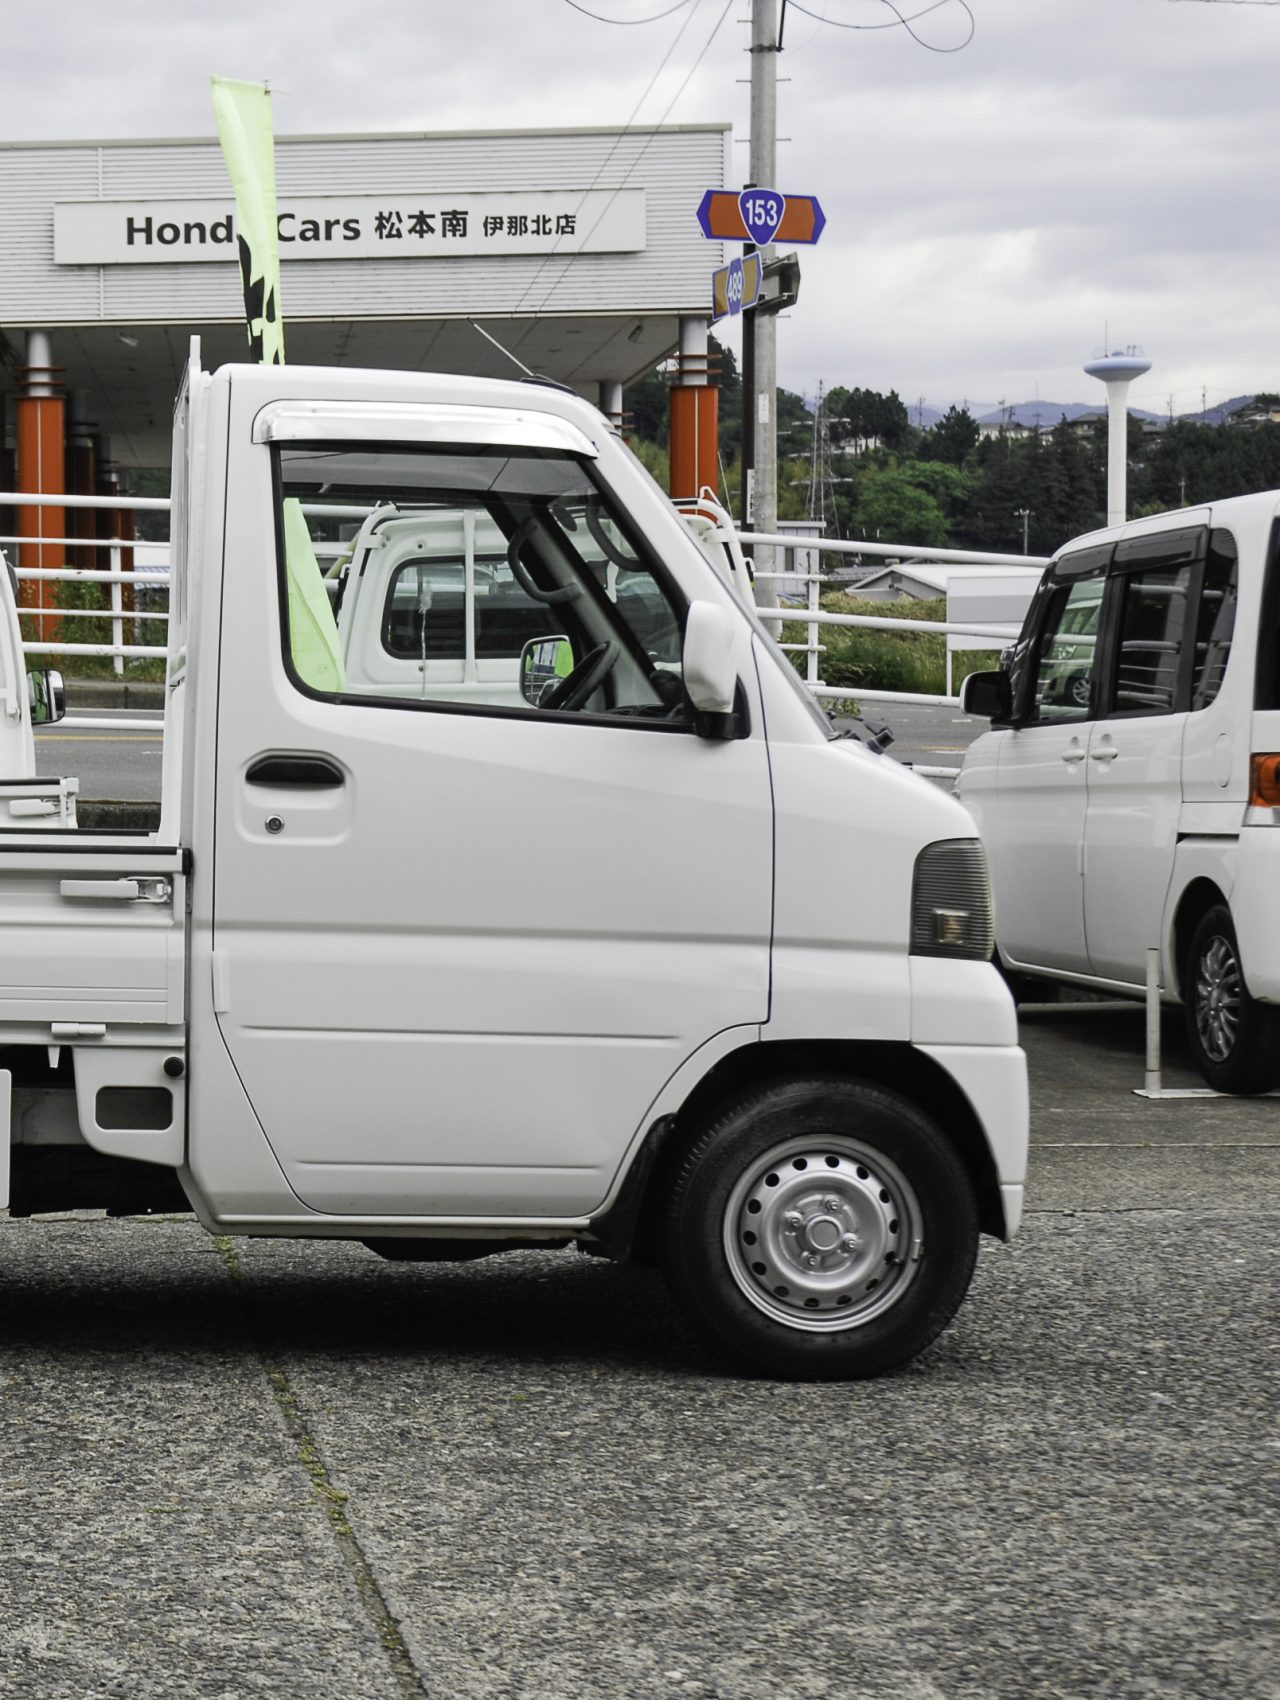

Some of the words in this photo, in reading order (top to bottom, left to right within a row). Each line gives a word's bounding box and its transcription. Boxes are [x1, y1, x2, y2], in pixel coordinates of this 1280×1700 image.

[126, 215, 237, 246] Hond
[276, 212, 361, 242] Cars
[374, 209, 469, 239] 松本南
[483, 214, 577, 238] 伊那北店
[745, 199, 778, 227] 153
[727, 270, 743, 303] 489
